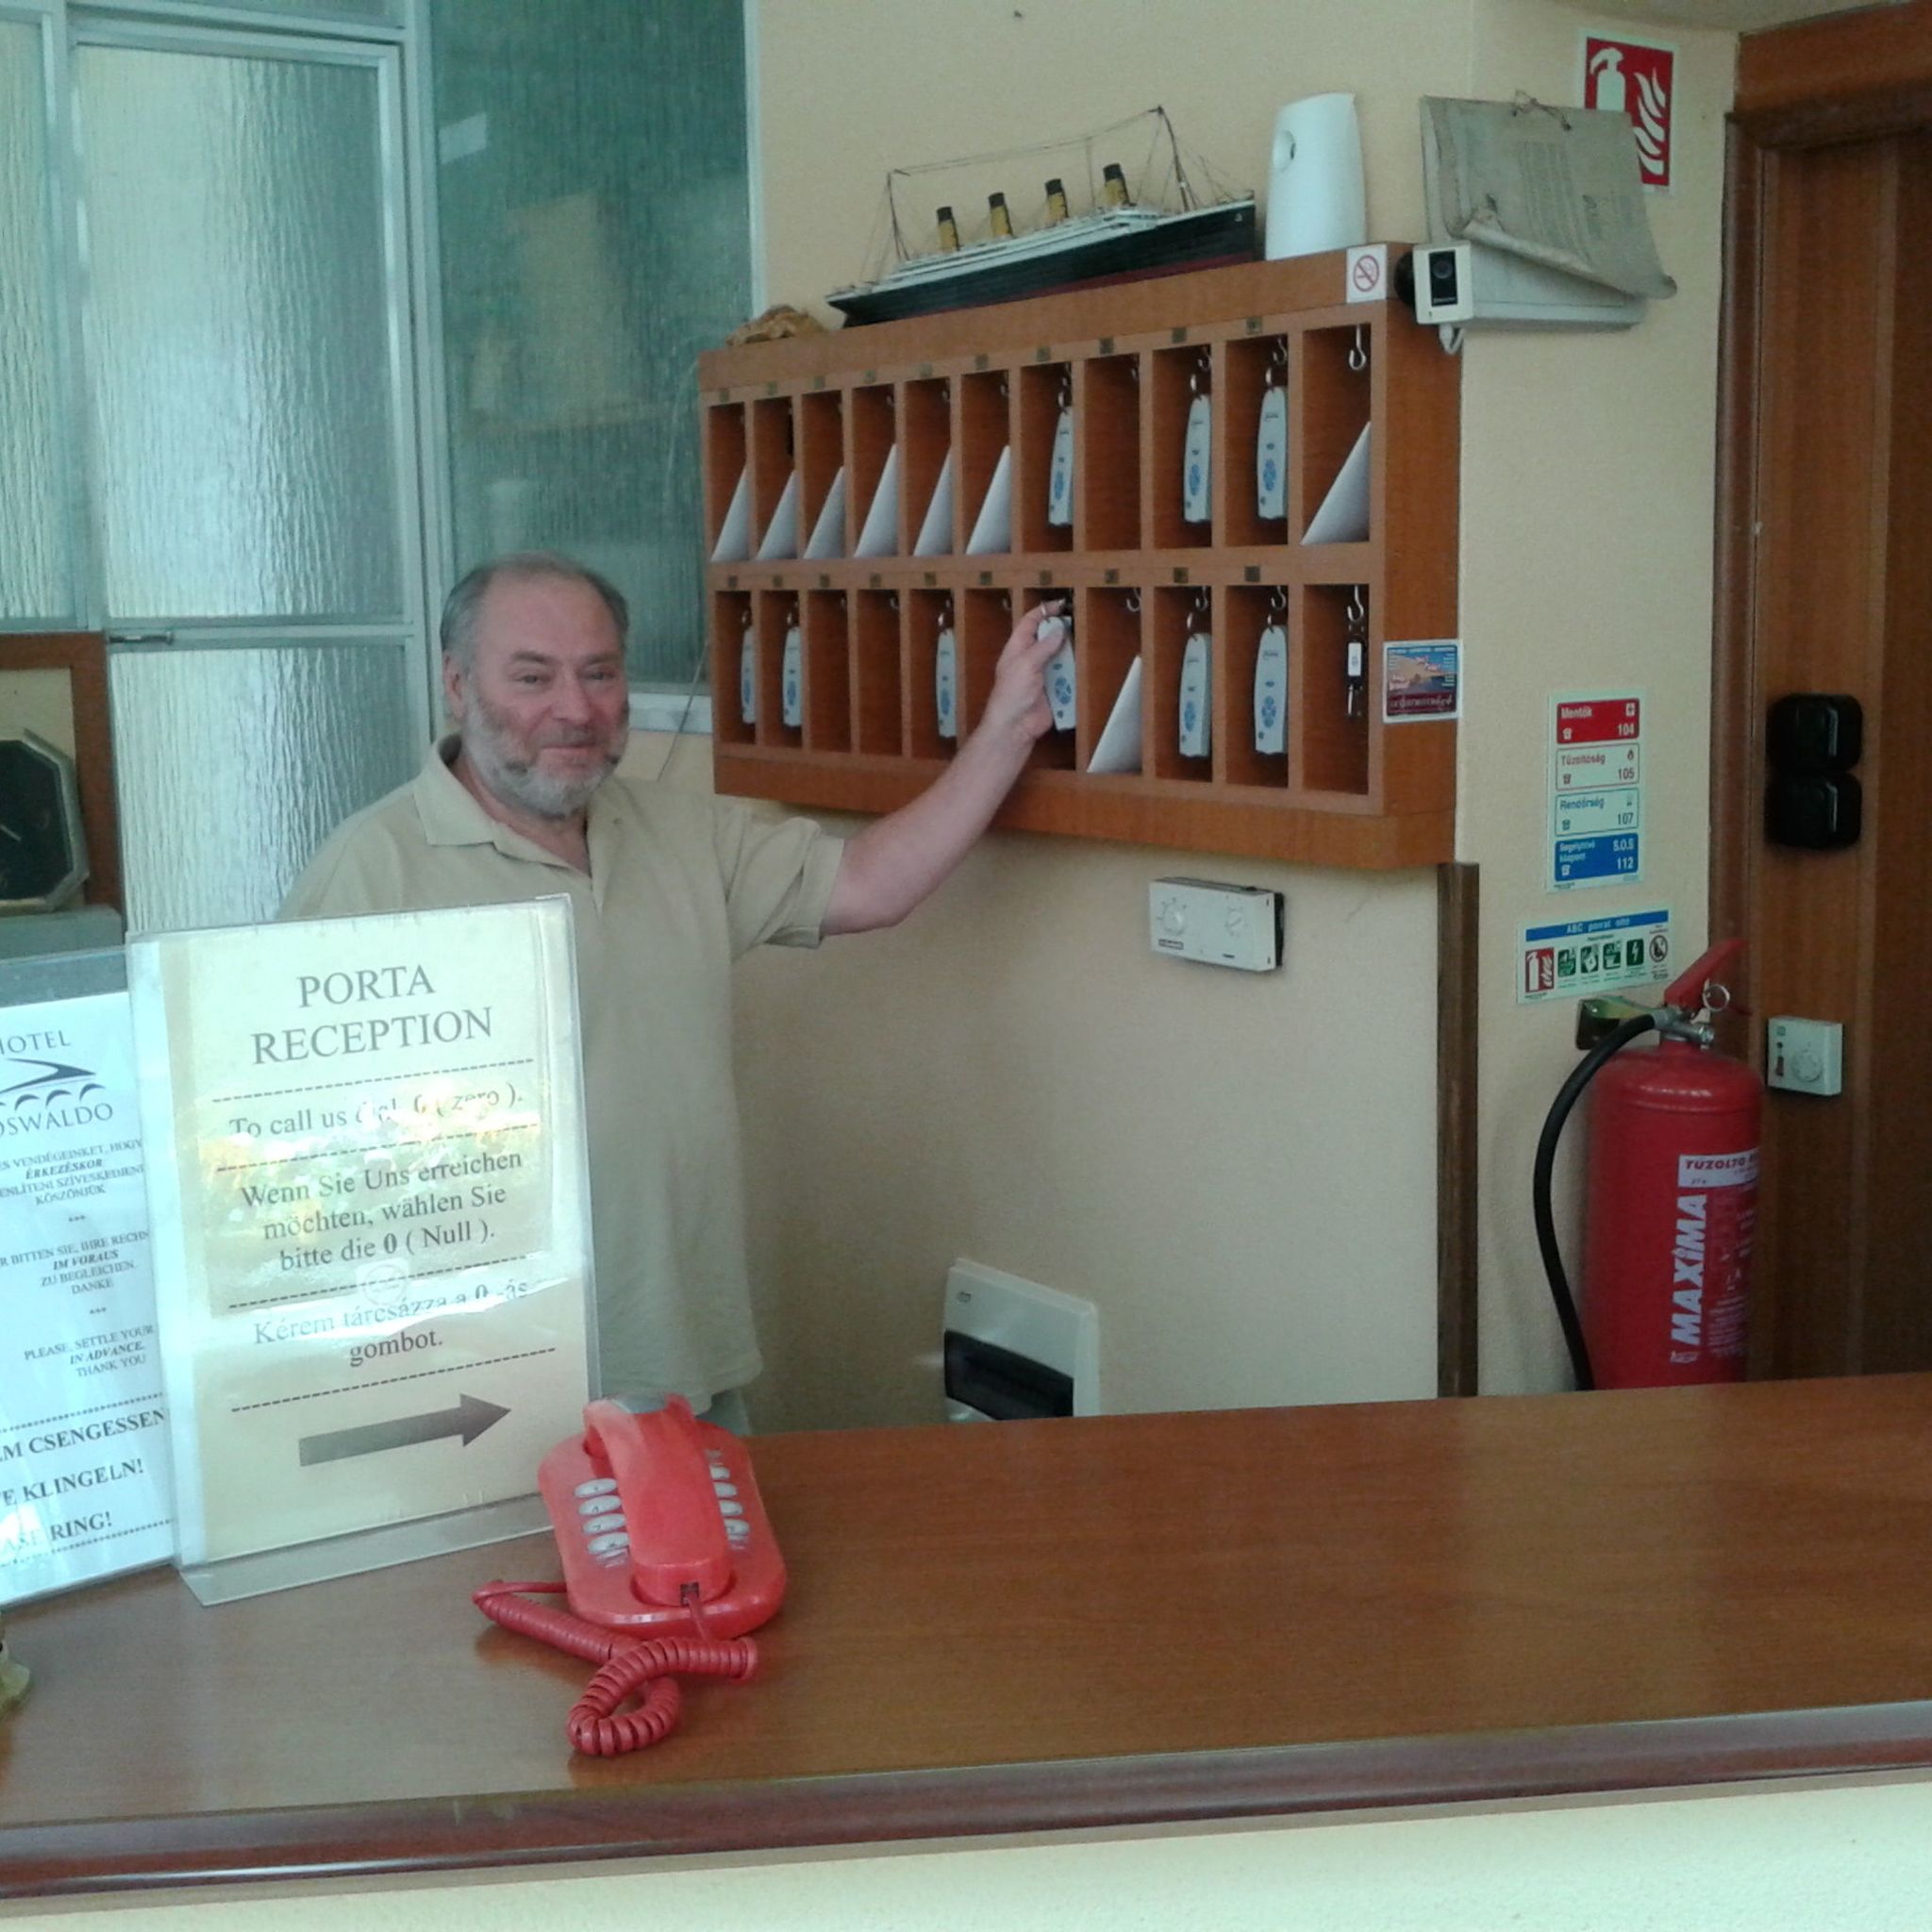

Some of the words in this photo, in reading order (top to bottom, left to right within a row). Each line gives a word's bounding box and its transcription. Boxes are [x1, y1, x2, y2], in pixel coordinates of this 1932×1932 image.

[1617, 723, 1635, 736] 104
[1618, 768, 1635, 780] 105
[1617, 812, 1634, 824] 107
[1617, 857, 1634, 870] 112
[1566, 923, 1583, 933] ABC
[296, 964, 437, 1008] PORTA
[251, 1006, 493, 1065] RECEPTION
[0, 1102, 113, 1137] SWALDO
[229, 1117, 261, 1138] To
[270, 1108, 313, 1135] call
[322, 1111, 347, 1129] us
[242, 1182, 309, 1208] Wenn
[318, 1172, 356, 1197] Sie
[364, 1168, 410, 1190] Uns
[417, 1152, 523, 1183] erreichen
[263, 1208, 375, 1241] möchten,
[381, 1191, 463, 1222] wählen
[471, 1183, 508, 1208] Sie
[10, 1247, 54, 1266] BITTEN
[81, 1236, 110, 1253] IHRE
[53, 1258, 69, 1271] IM
[72, 1249, 119, 1267] VORAUS
[279, 1240, 333, 1272] bitte
[341, 1234, 376, 1261] die
[383, 1233, 398, 1255] 0
[422, 1221, 472, 1248] Null
[42, 1274, 58, 1287] ZU
[71, 1277, 114, 1295] DANKE
[254, 1316, 336, 1345] Kérem
[343, 1295, 448, 1328] tárcsázza
[75, 1330, 119, 1349] SETTLE
[120, 1324, 155, 1340] YOUR
[349, 1328, 443, 1367] gombot.
[70, 1355, 85, 1365] IN
[76, 1360, 118, 1377] THANK
[28, 1408, 165, 1454] CSENGESSEN
[0, 1488, 17, 1507] E
[23, 1458, 143, 1502] KLINGELN!
[50, 1510, 112, 1541] RING!
